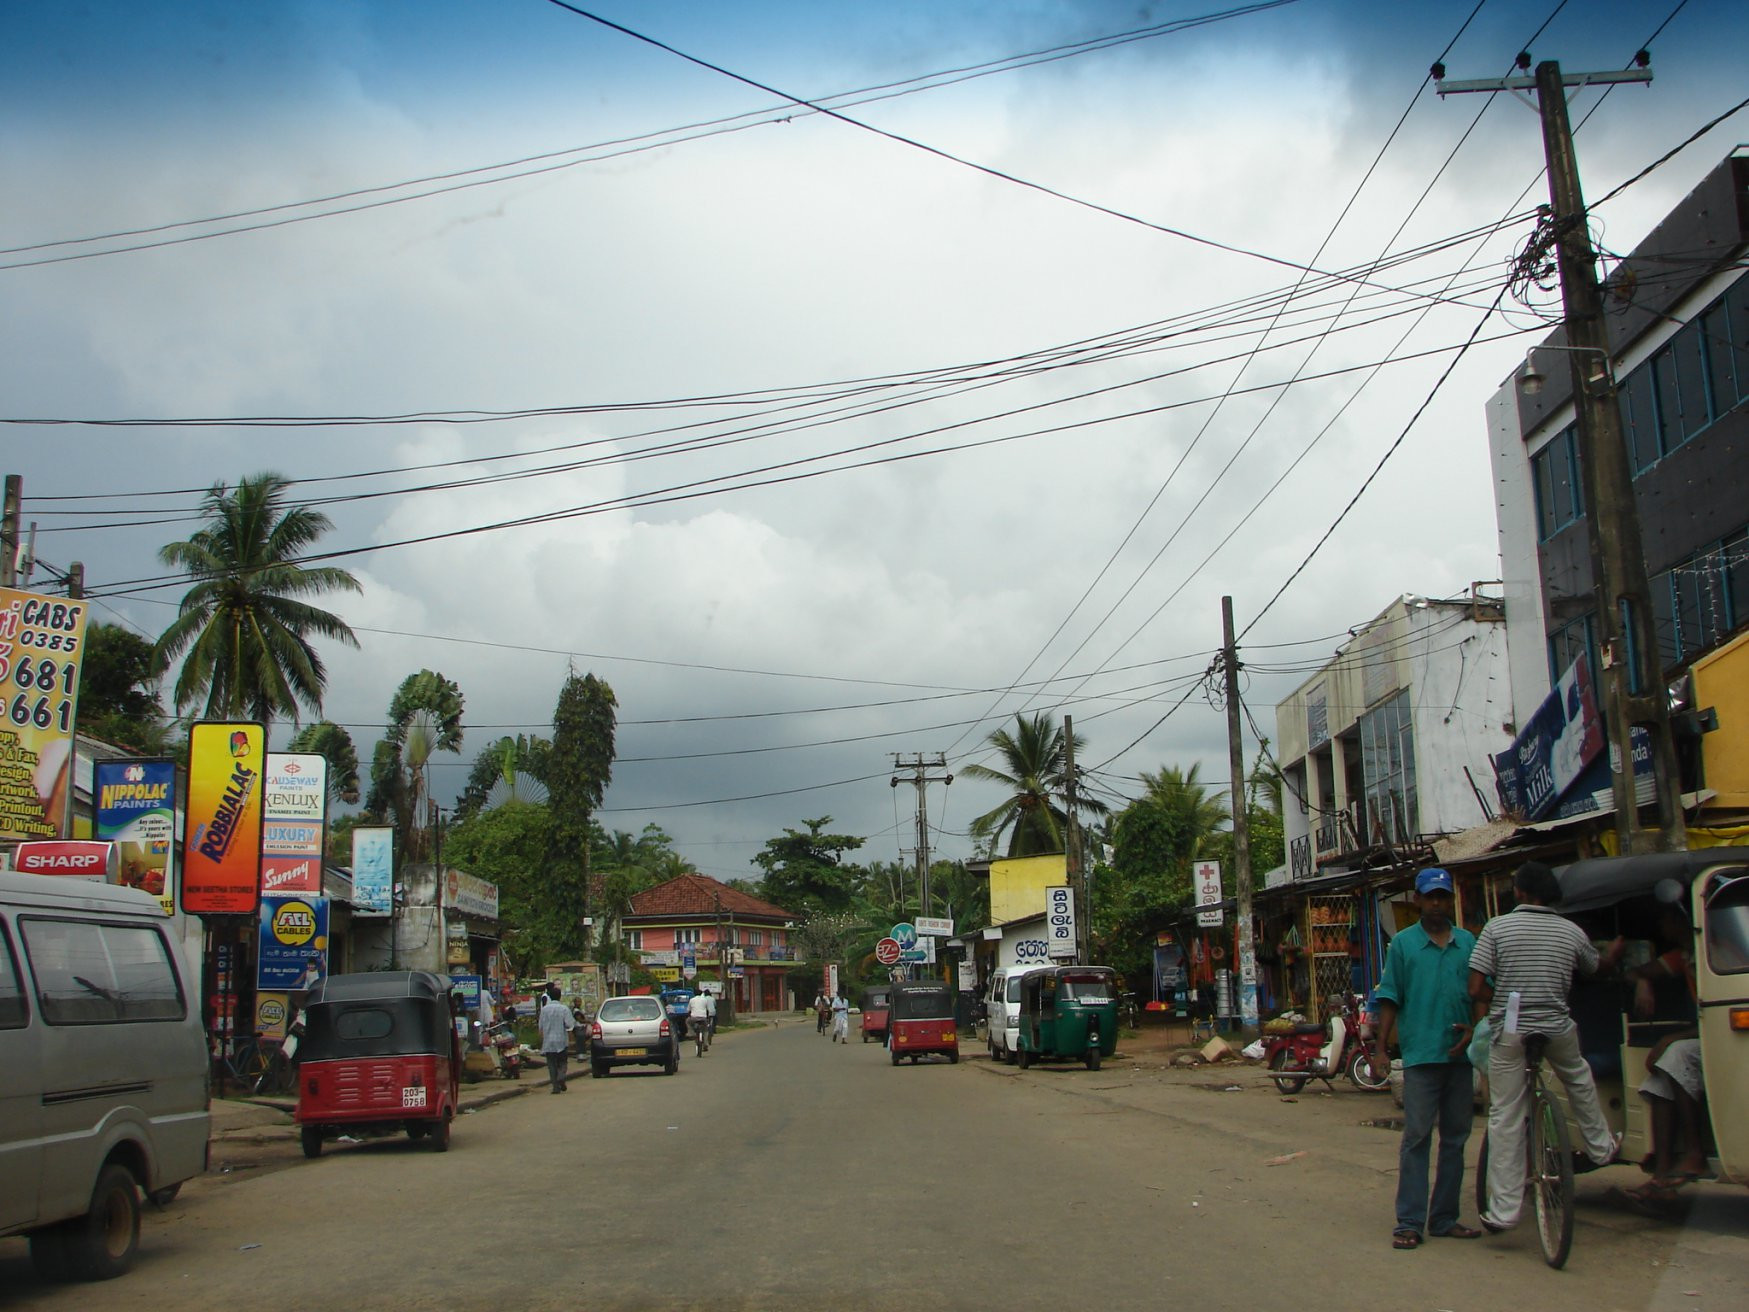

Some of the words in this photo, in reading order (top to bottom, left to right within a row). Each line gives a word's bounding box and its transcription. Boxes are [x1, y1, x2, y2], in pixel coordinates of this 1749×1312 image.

[23, 599, 81, 631] CABS
[21, 630, 77, 652] 0385
[15, 656, 76, 695] 681
[11, 693, 71, 732] 661
[17, 750, 39, 766] Fax,
[101, 783, 168, 809] NIPPOLAC
[1526, 763, 1553, 809] Milk
[113, 800, 160, 808] PAINTS
[200, 762, 254, 864] ROBBIALAC
[15, 818, 57, 837] Writing,
[25, 855, 99, 868] SHARP
[265, 861, 309, 888] Sunny
